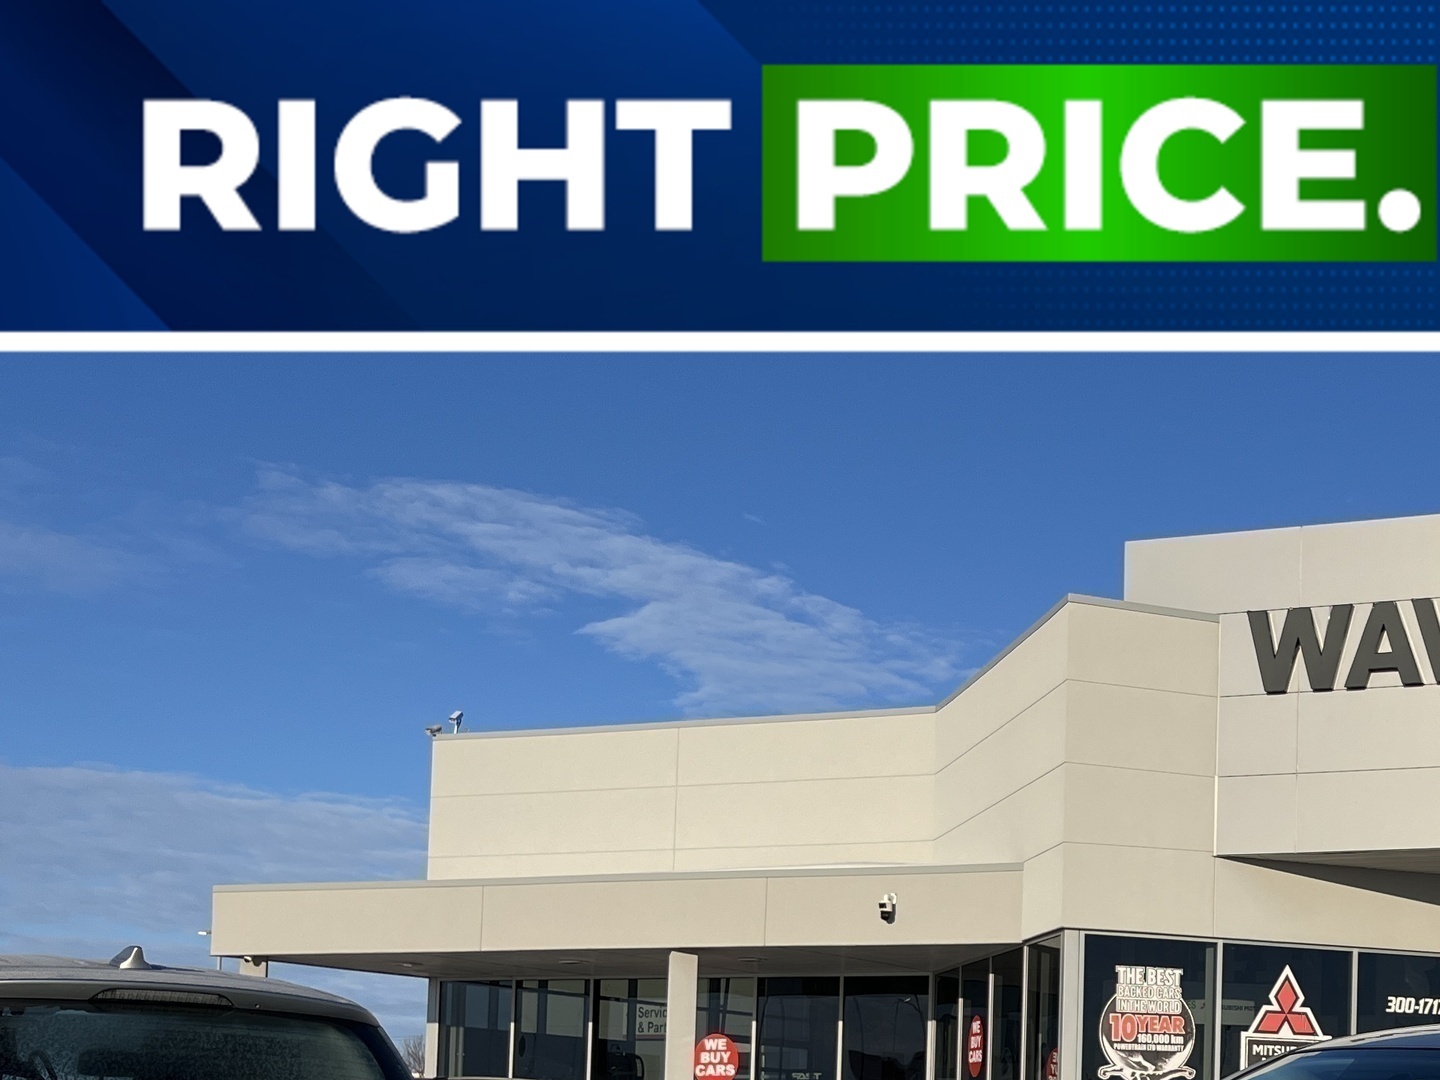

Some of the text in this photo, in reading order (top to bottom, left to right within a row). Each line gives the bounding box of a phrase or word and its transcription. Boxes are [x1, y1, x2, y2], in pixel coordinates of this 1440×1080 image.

[1117, 967, 1182, 986] THE BEST
[1118, 985, 1182, 999] BACKED CARS
[1118, 999, 1128, 1011] IN
[1128, 999, 1147, 1012] THE
[1148, 1000, 1182, 1013] WORLD
[638, 1021, 644, 1033] &
[972, 1020, 981, 1034] WE
[1110, 1013, 1185, 1042] 10 YEAR
[704, 1038, 727, 1050] WE
[970, 1035, 982, 1049] BUY
[1137, 1033, 1184, 1044] 160,000 km
[700, 1051, 731, 1063] BUY
[968, 1050, 982, 1063] CARS
[695, 1064, 735, 1077] CARS
